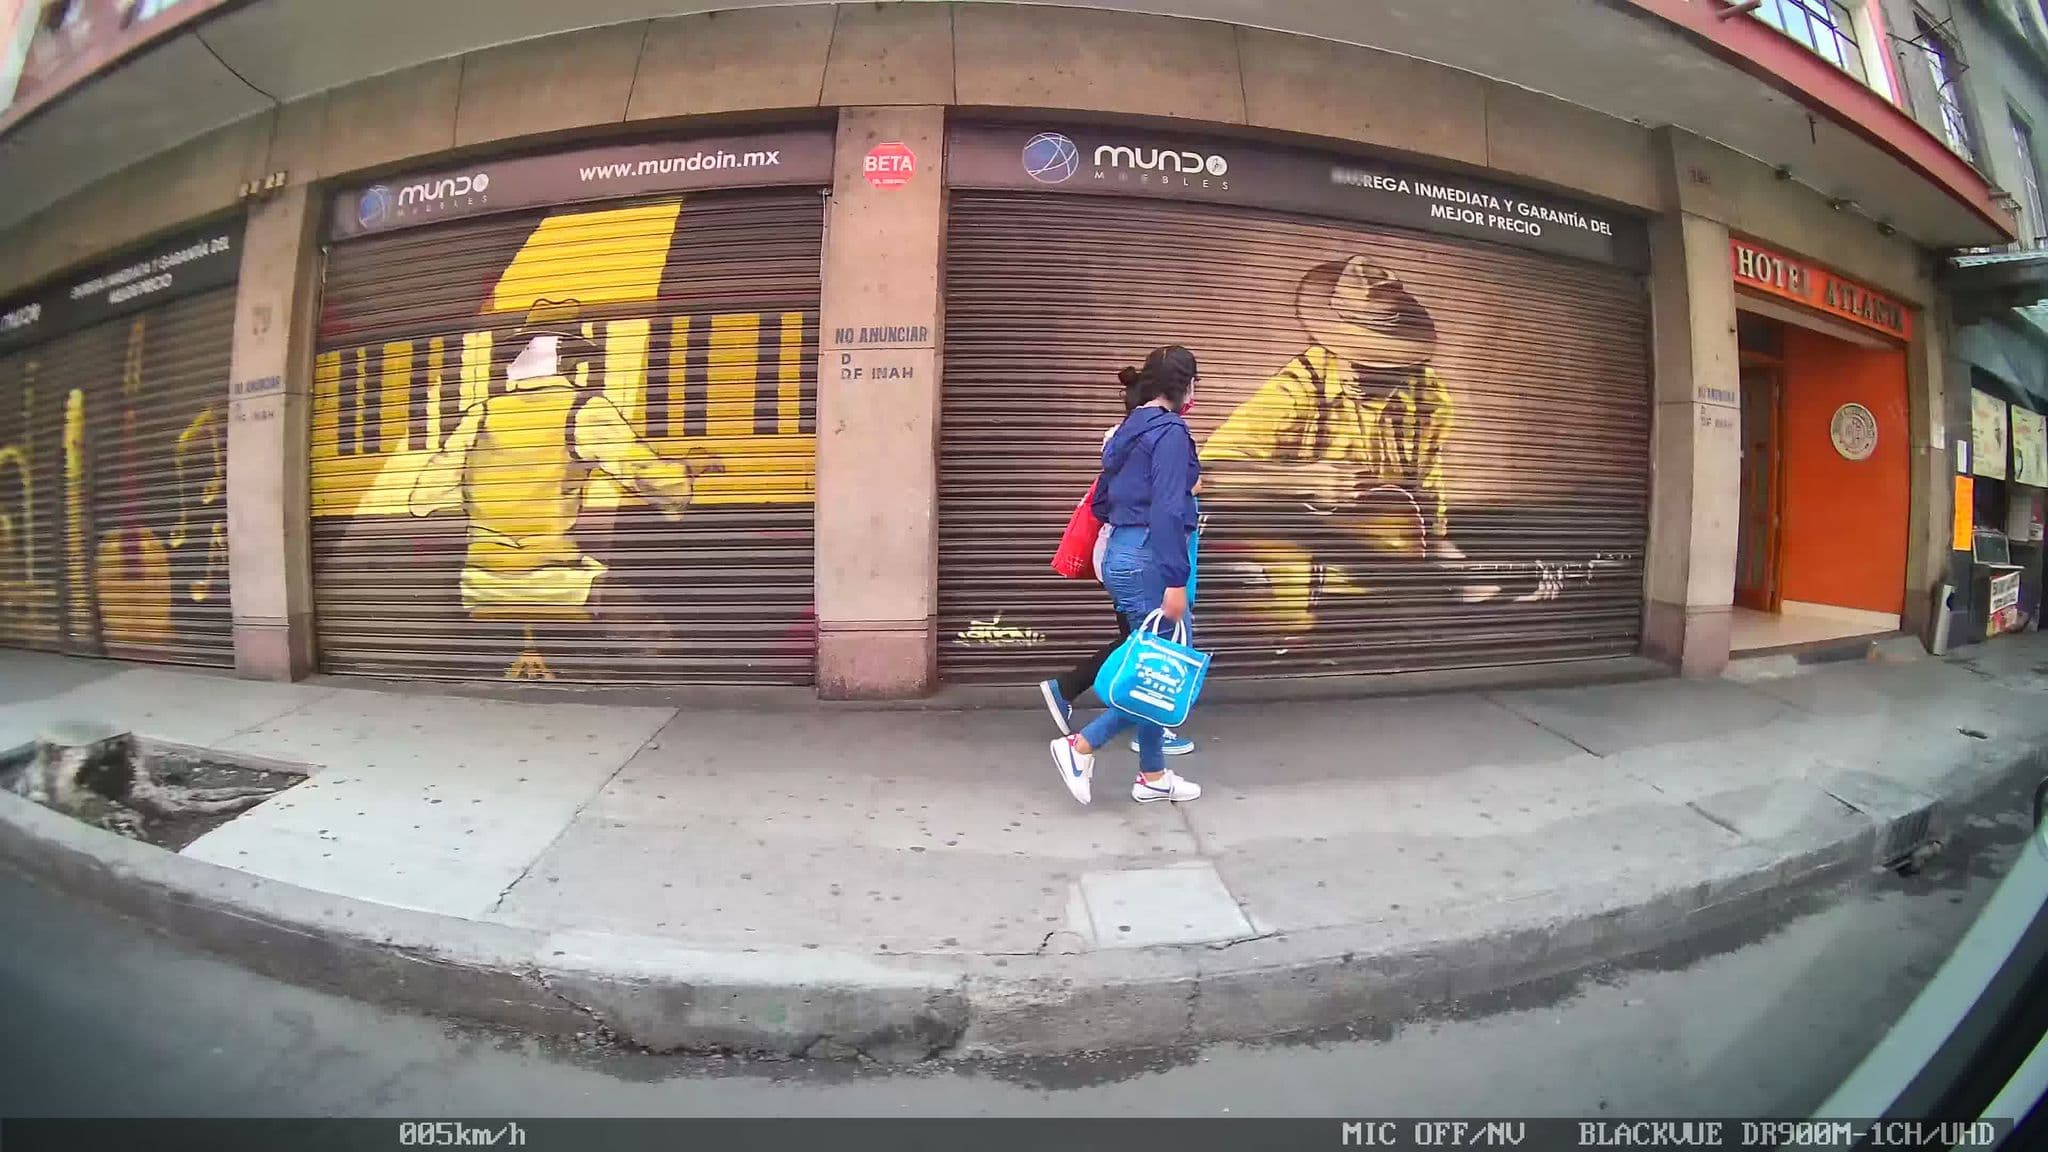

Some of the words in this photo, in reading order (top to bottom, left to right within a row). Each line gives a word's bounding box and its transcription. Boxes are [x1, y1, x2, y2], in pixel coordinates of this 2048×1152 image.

[580, 150, 780, 181] www.mundoin.mx
[865, 155, 913, 172] BETA
[397, 195, 488, 216] MEBLES
[1331, 166, 1410, 195] REGA
[1415, 182, 1500, 210] INMEDIATA
[1503, 199, 1514, 213] Y
[1517, 203, 1588, 230] GARANTÍA
[1591, 220, 1613, 236] DEL
[1431, 204, 1485, 225] MEJOR
[1488, 214, 1541, 236] PRECIO
[1737, 246, 1812, 296] HOTEL
[835, 328, 854, 344] NO
[859, 326, 928, 342] ANUNCIAR
[871, 367, 914, 379] INAH
